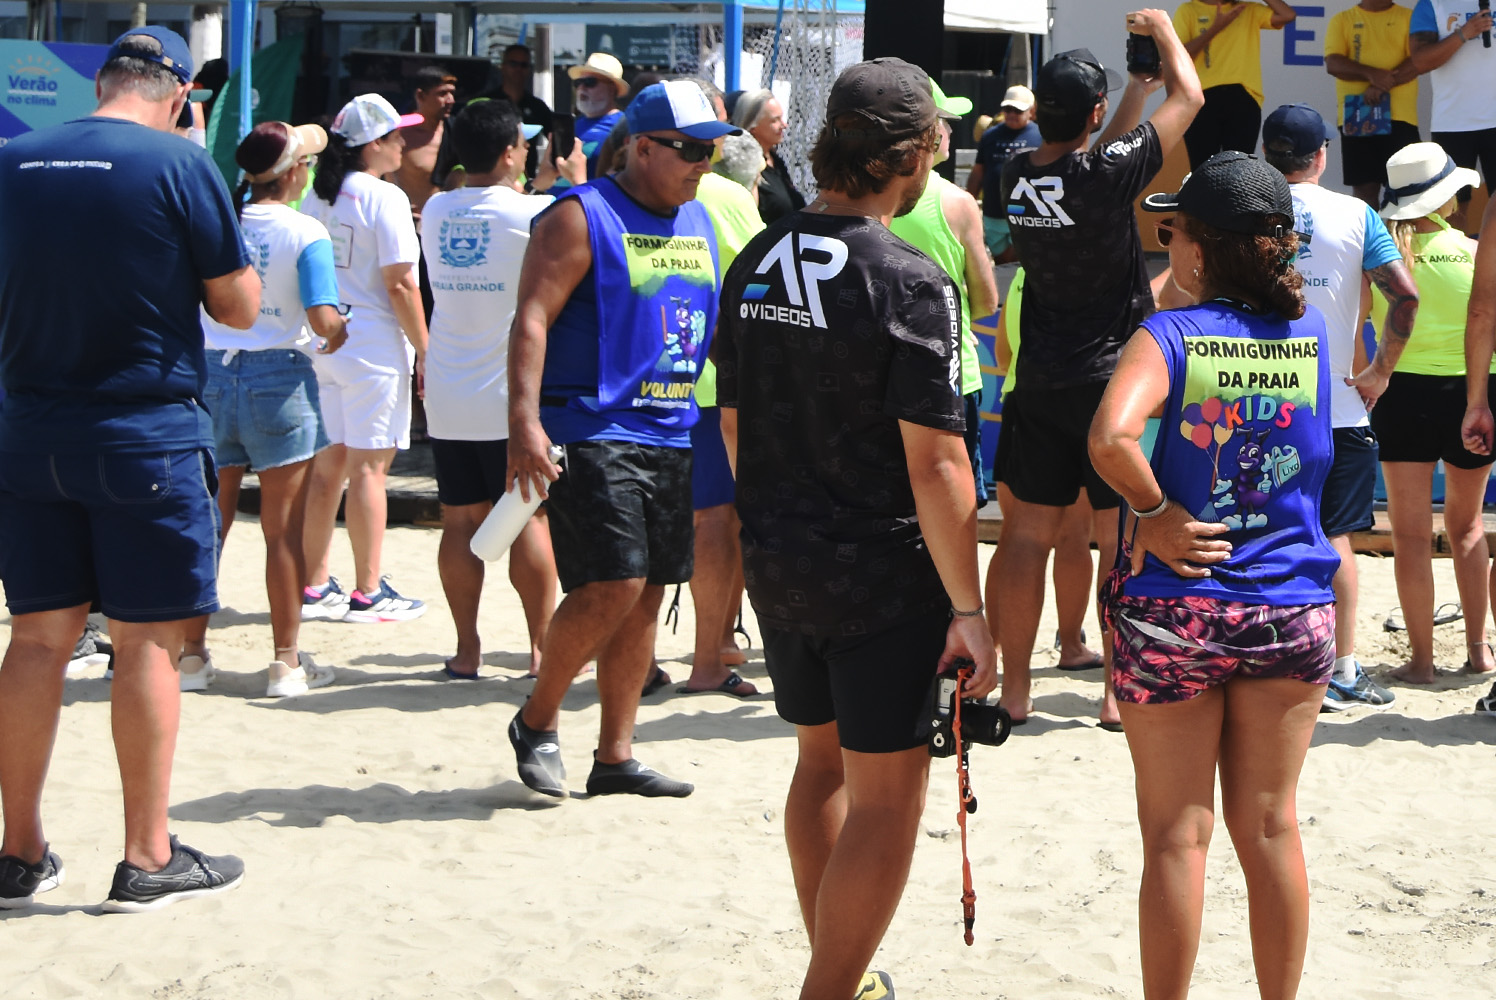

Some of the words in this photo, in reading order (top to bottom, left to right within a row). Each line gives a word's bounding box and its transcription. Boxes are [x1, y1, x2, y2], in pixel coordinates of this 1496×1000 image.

[7, 75, 58, 92] Verão
[7, 95, 22, 105] no
[26, 94, 57, 106] clima
[651, 257, 668, 269] DA
[670, 258, 702, 270] PRAIA
[1429, 254, 1468, 264] AMIGOS
[456, 282, 505, 292] GRANDE
[1186, 340, 1318, 360] FORMIGUINHAS
[1218, 371, 1244, 388] DA
[1248, 372, 1300, 389] PRAIA
[1224, 396, 1296, 431] KIDS
[1282, 462, 1300, 477] Lixo
